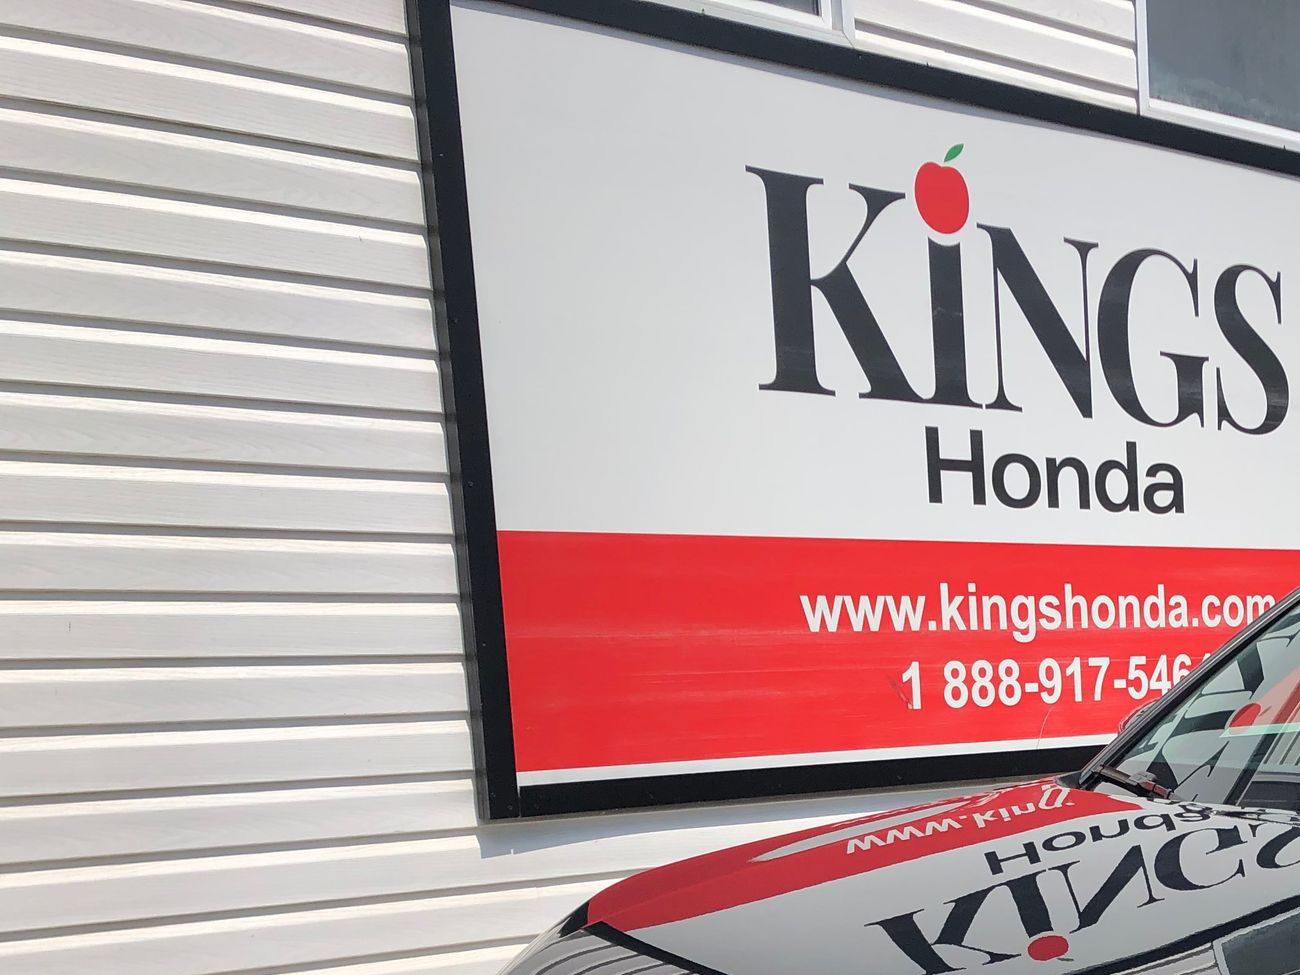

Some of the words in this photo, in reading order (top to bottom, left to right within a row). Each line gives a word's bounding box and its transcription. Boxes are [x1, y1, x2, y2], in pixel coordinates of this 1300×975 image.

[925, 427, 1185, 514] Honda
[800, 582, 1275, 643] www.kingshonda.com
[902, 661, 922, 709] 1
[943, 653, 1210, 709] 888-917-546
